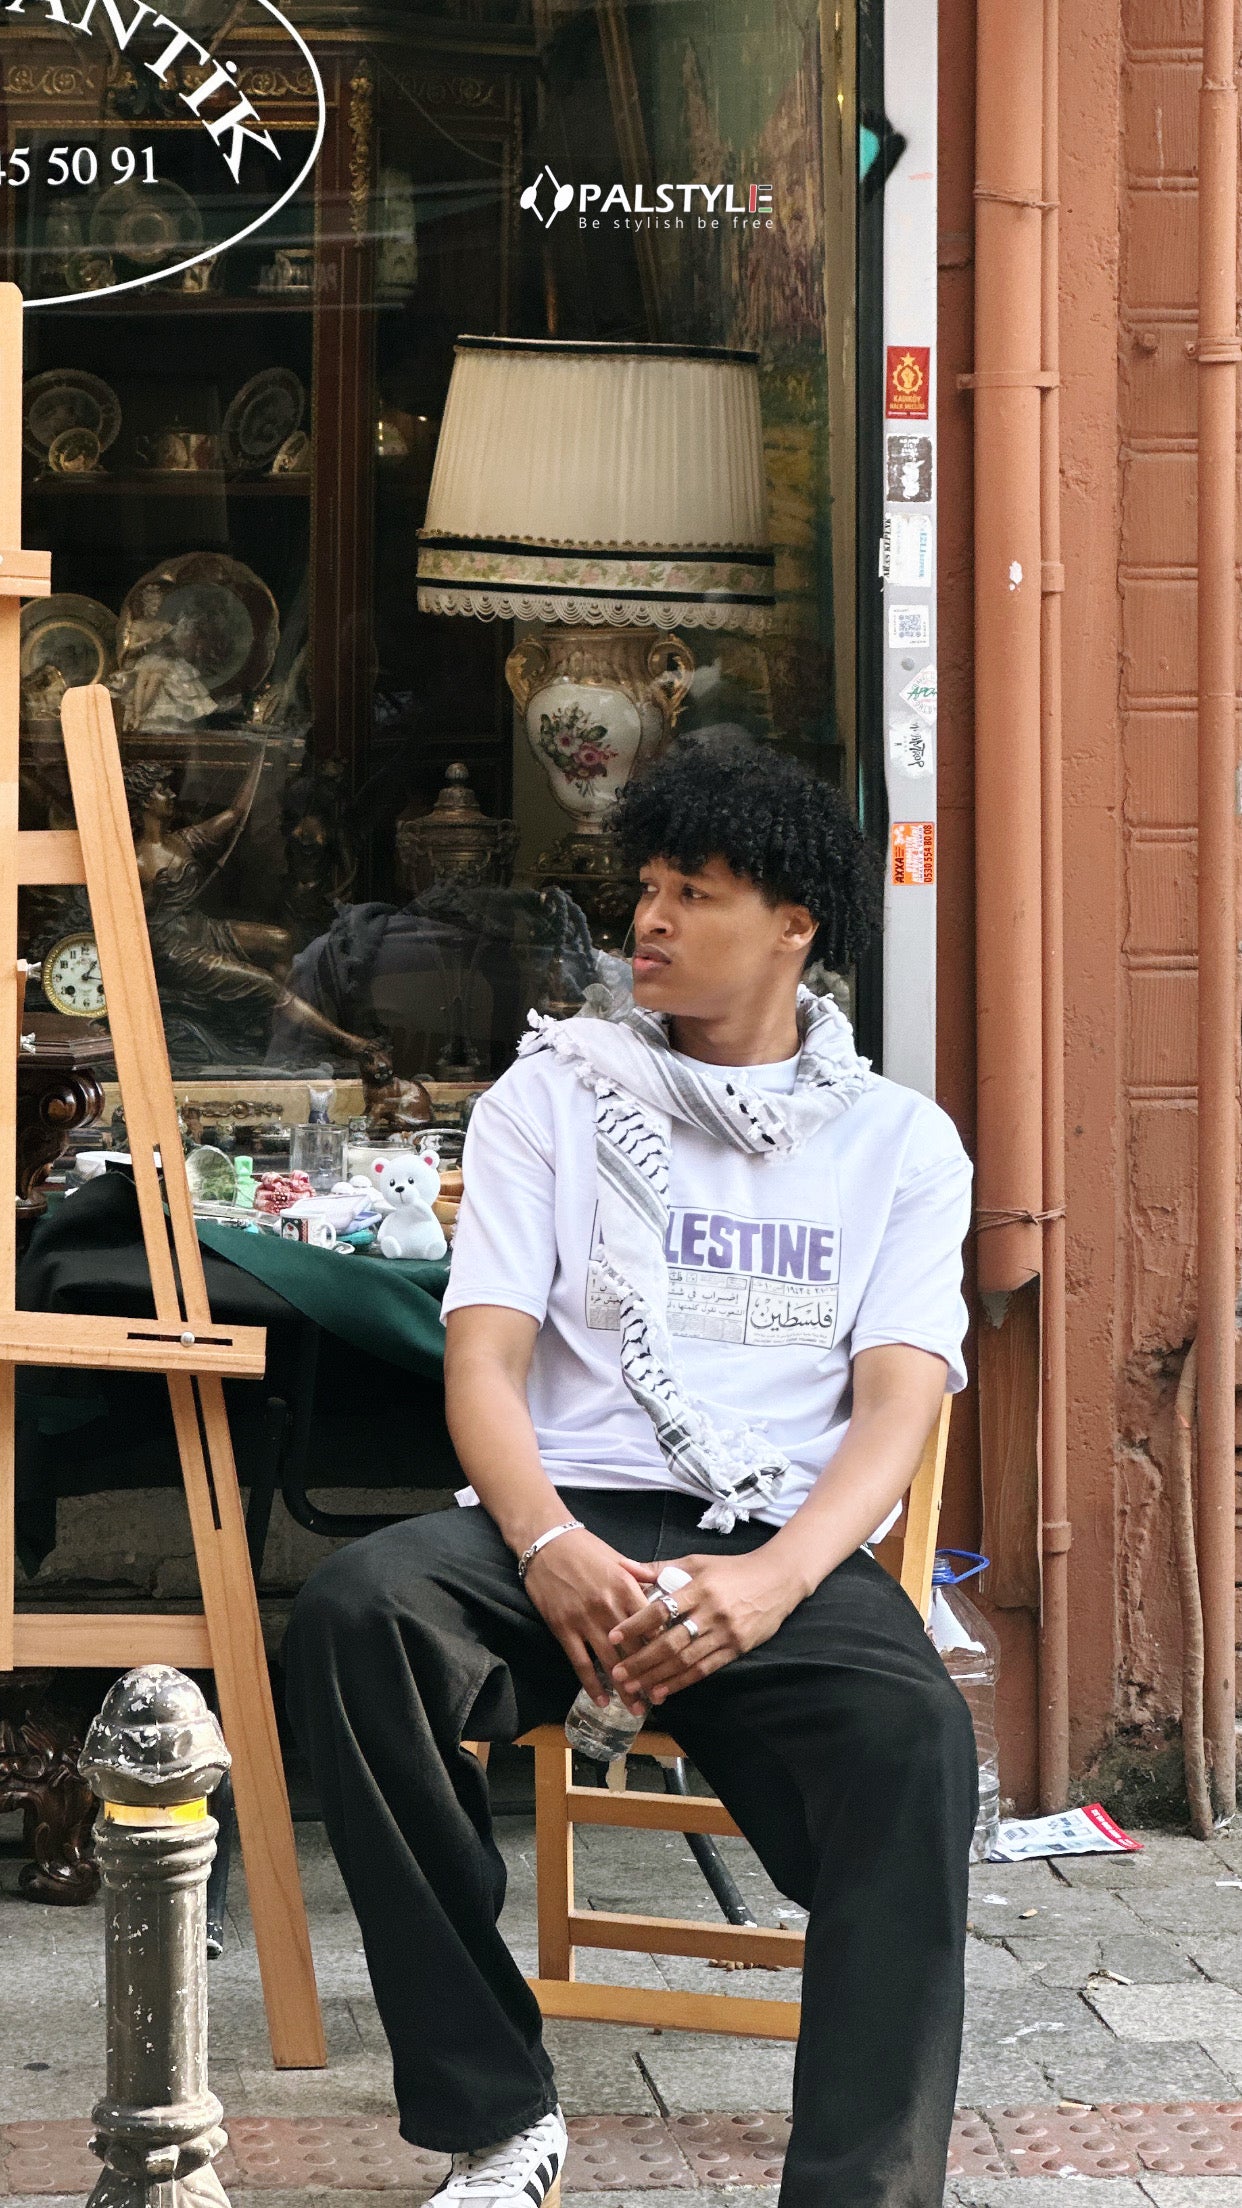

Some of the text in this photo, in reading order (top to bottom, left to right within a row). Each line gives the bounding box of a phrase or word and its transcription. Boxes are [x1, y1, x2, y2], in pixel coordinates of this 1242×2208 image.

[0, 146, 159, 186] 5 50 91
[923, 825, 932, 835] 08
[924, 847, 932, 862] 554
[895, 858, 904, 883] AXXA
[924, 863, 932, 883] 0530
[666, 1212, 834, 1281] LESTINE
